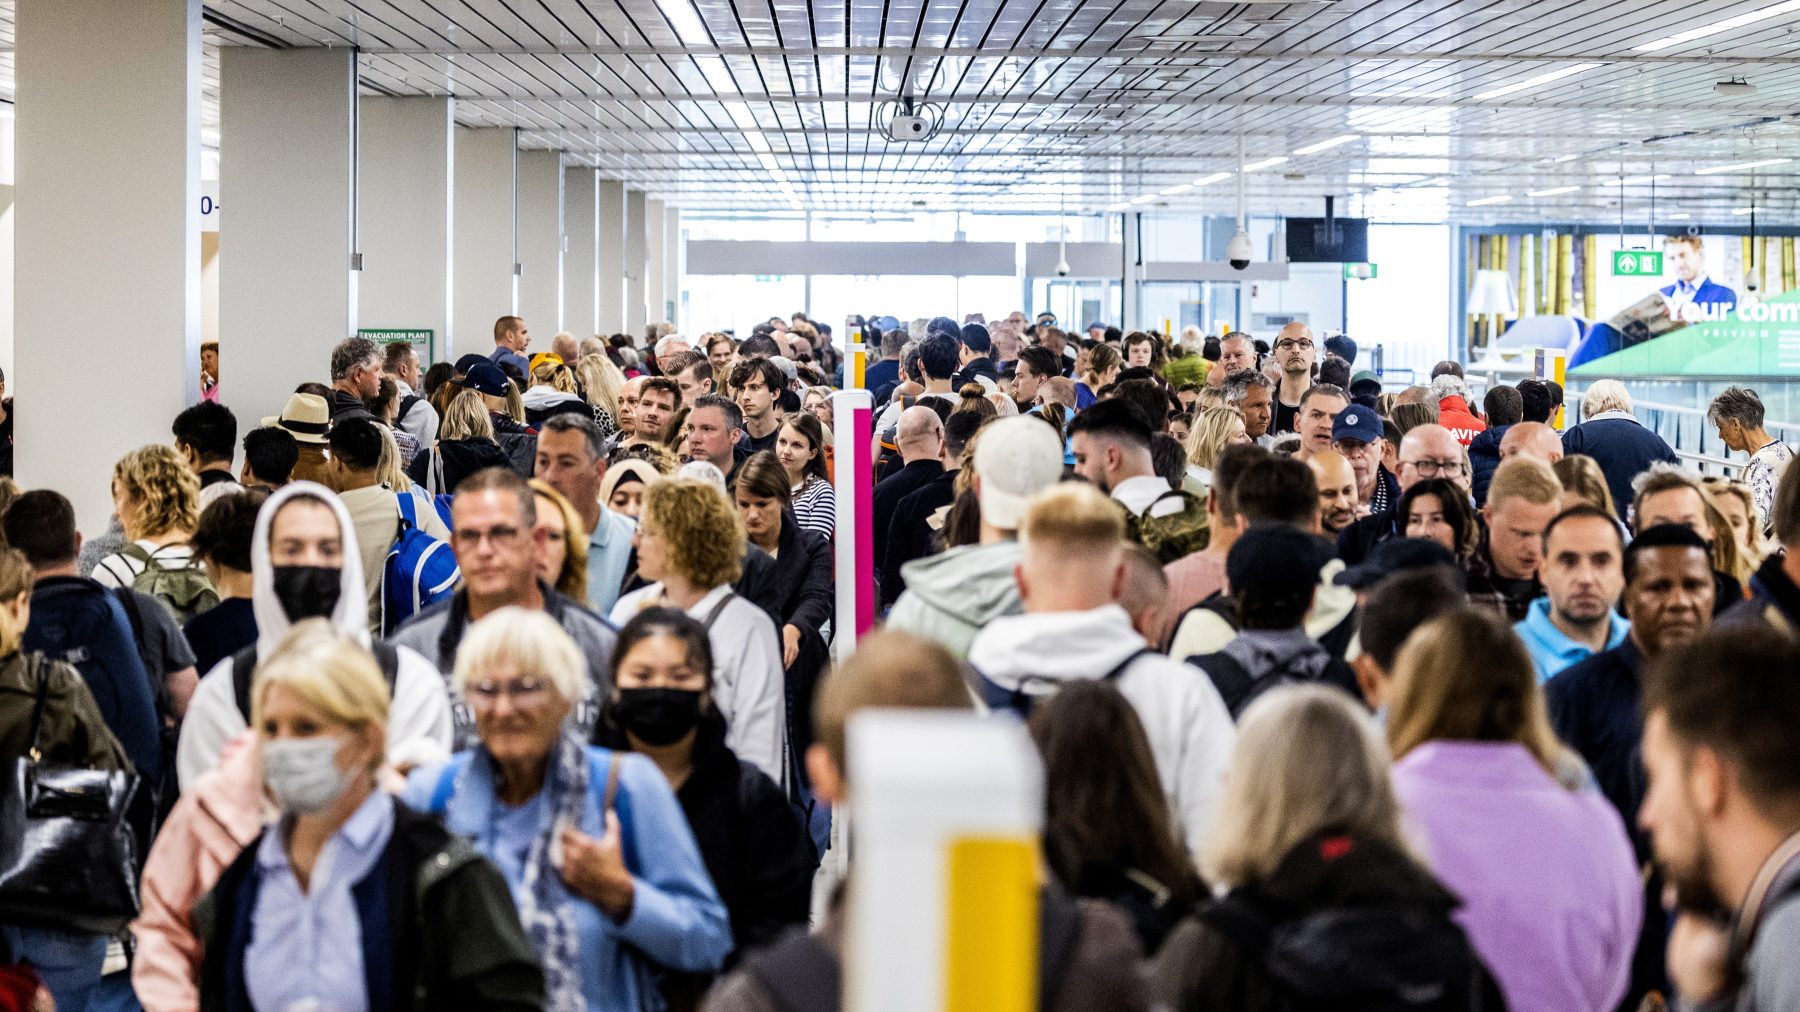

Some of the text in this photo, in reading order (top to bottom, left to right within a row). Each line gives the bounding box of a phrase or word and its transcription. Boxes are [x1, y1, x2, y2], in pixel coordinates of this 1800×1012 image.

[1664, 295, 1800, 322] Your com
[1703, 328, 1768, 338] PRIVIUM
